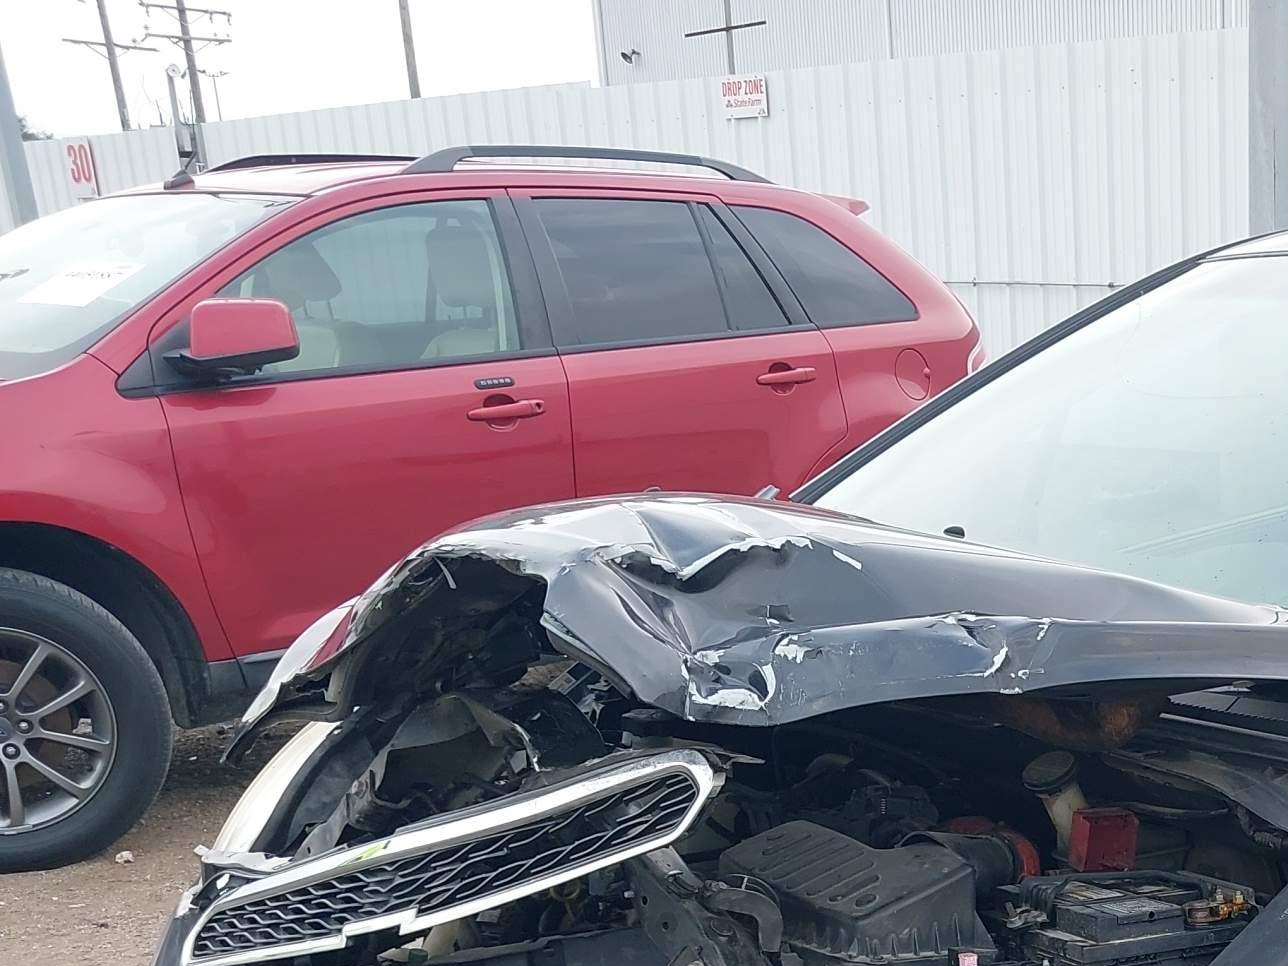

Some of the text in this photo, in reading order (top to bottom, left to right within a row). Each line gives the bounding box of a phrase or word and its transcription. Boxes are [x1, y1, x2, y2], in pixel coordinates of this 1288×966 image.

[721, 78, 764, 97] DROP ZONE
[67, 144, 92, 183] 30
